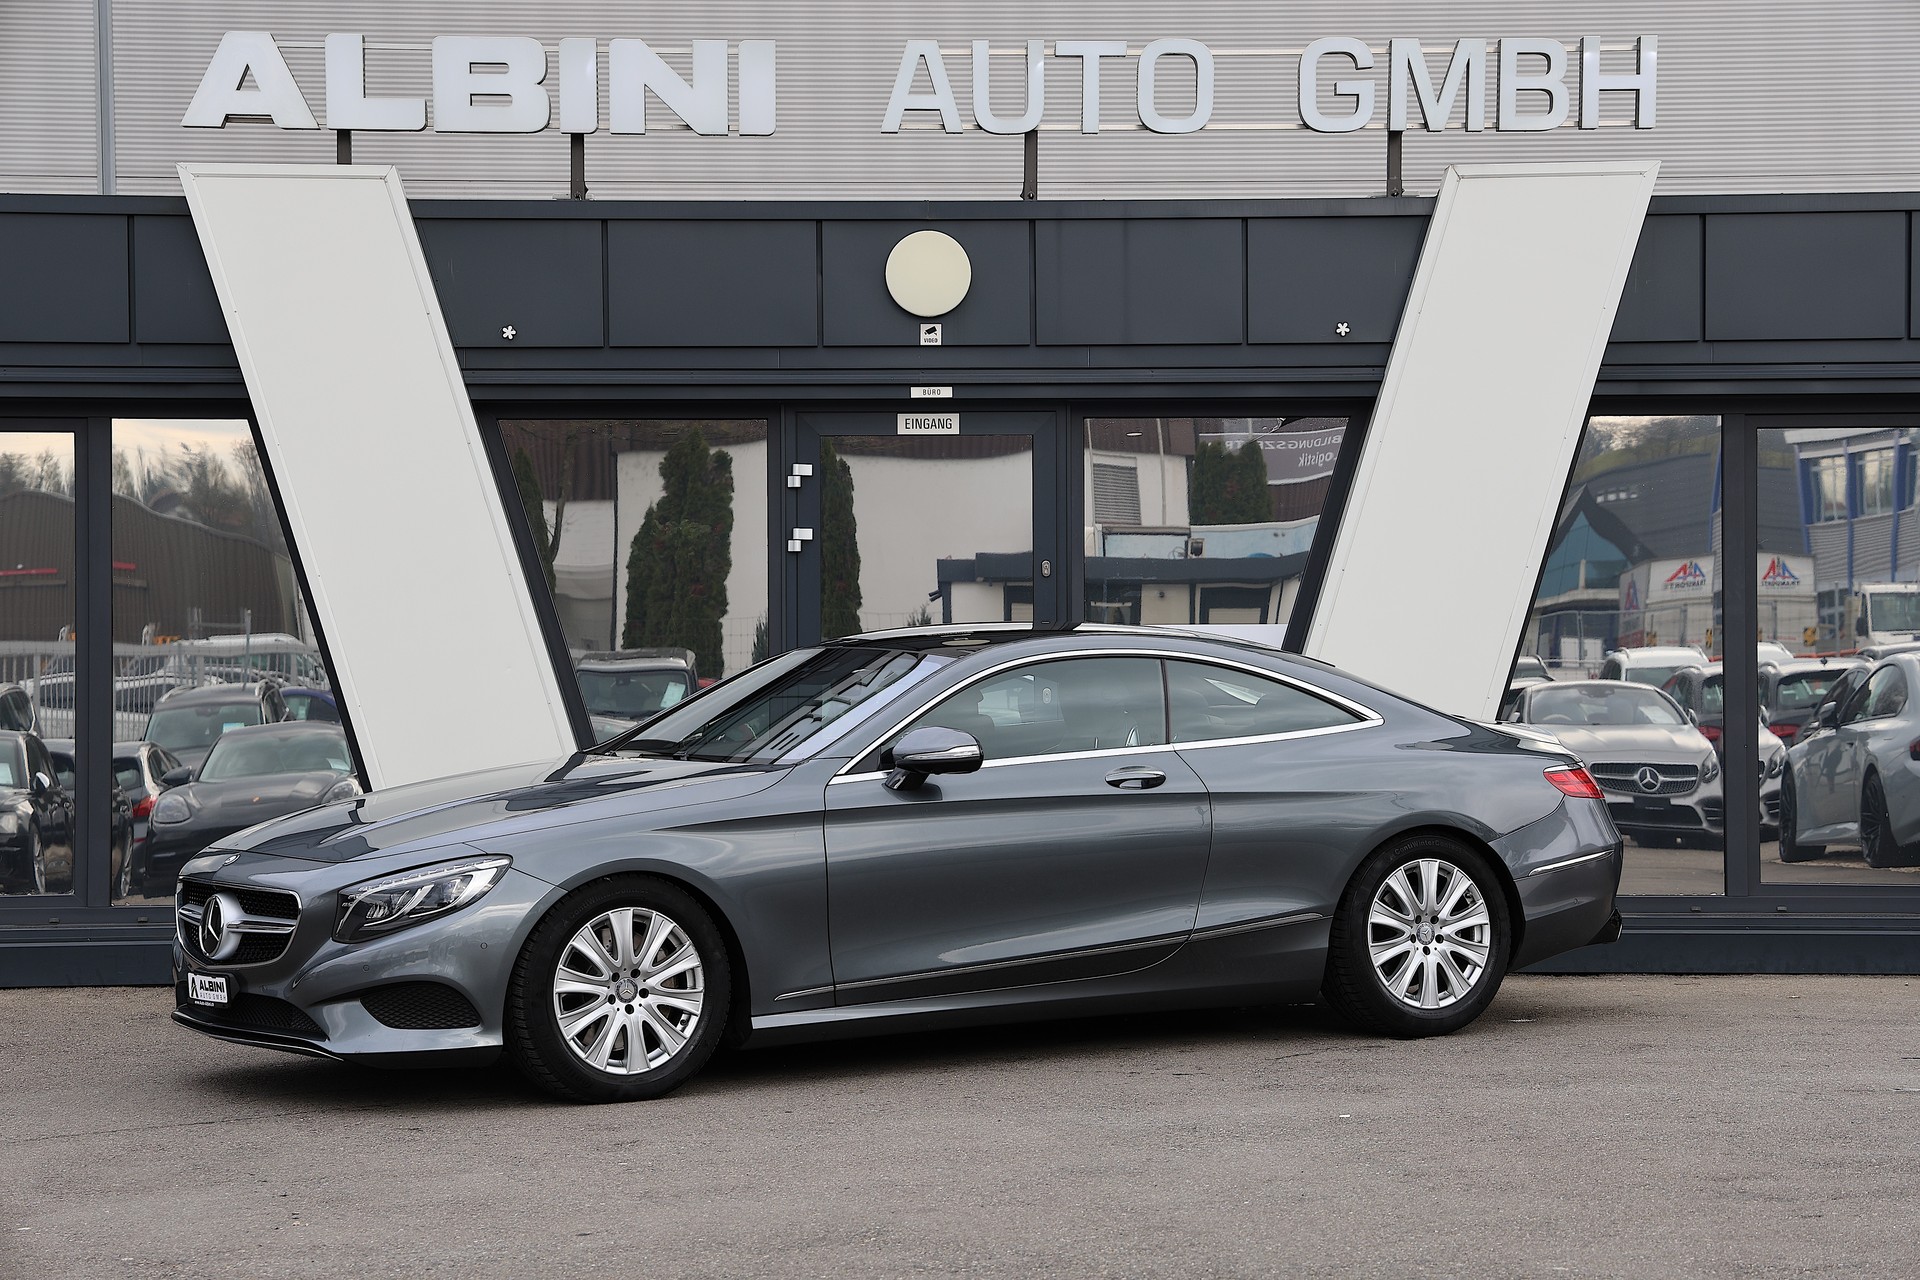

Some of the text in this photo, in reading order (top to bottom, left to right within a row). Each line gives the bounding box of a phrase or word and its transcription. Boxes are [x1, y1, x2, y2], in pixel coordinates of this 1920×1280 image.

[180, 30, 1659, 136] ALBINI AUTO GMBH
[922, 388, 941, 396] BÜRO
[904, 417, 953, 430] EINGANG
[200, 979, 225, 993] ALBINI
